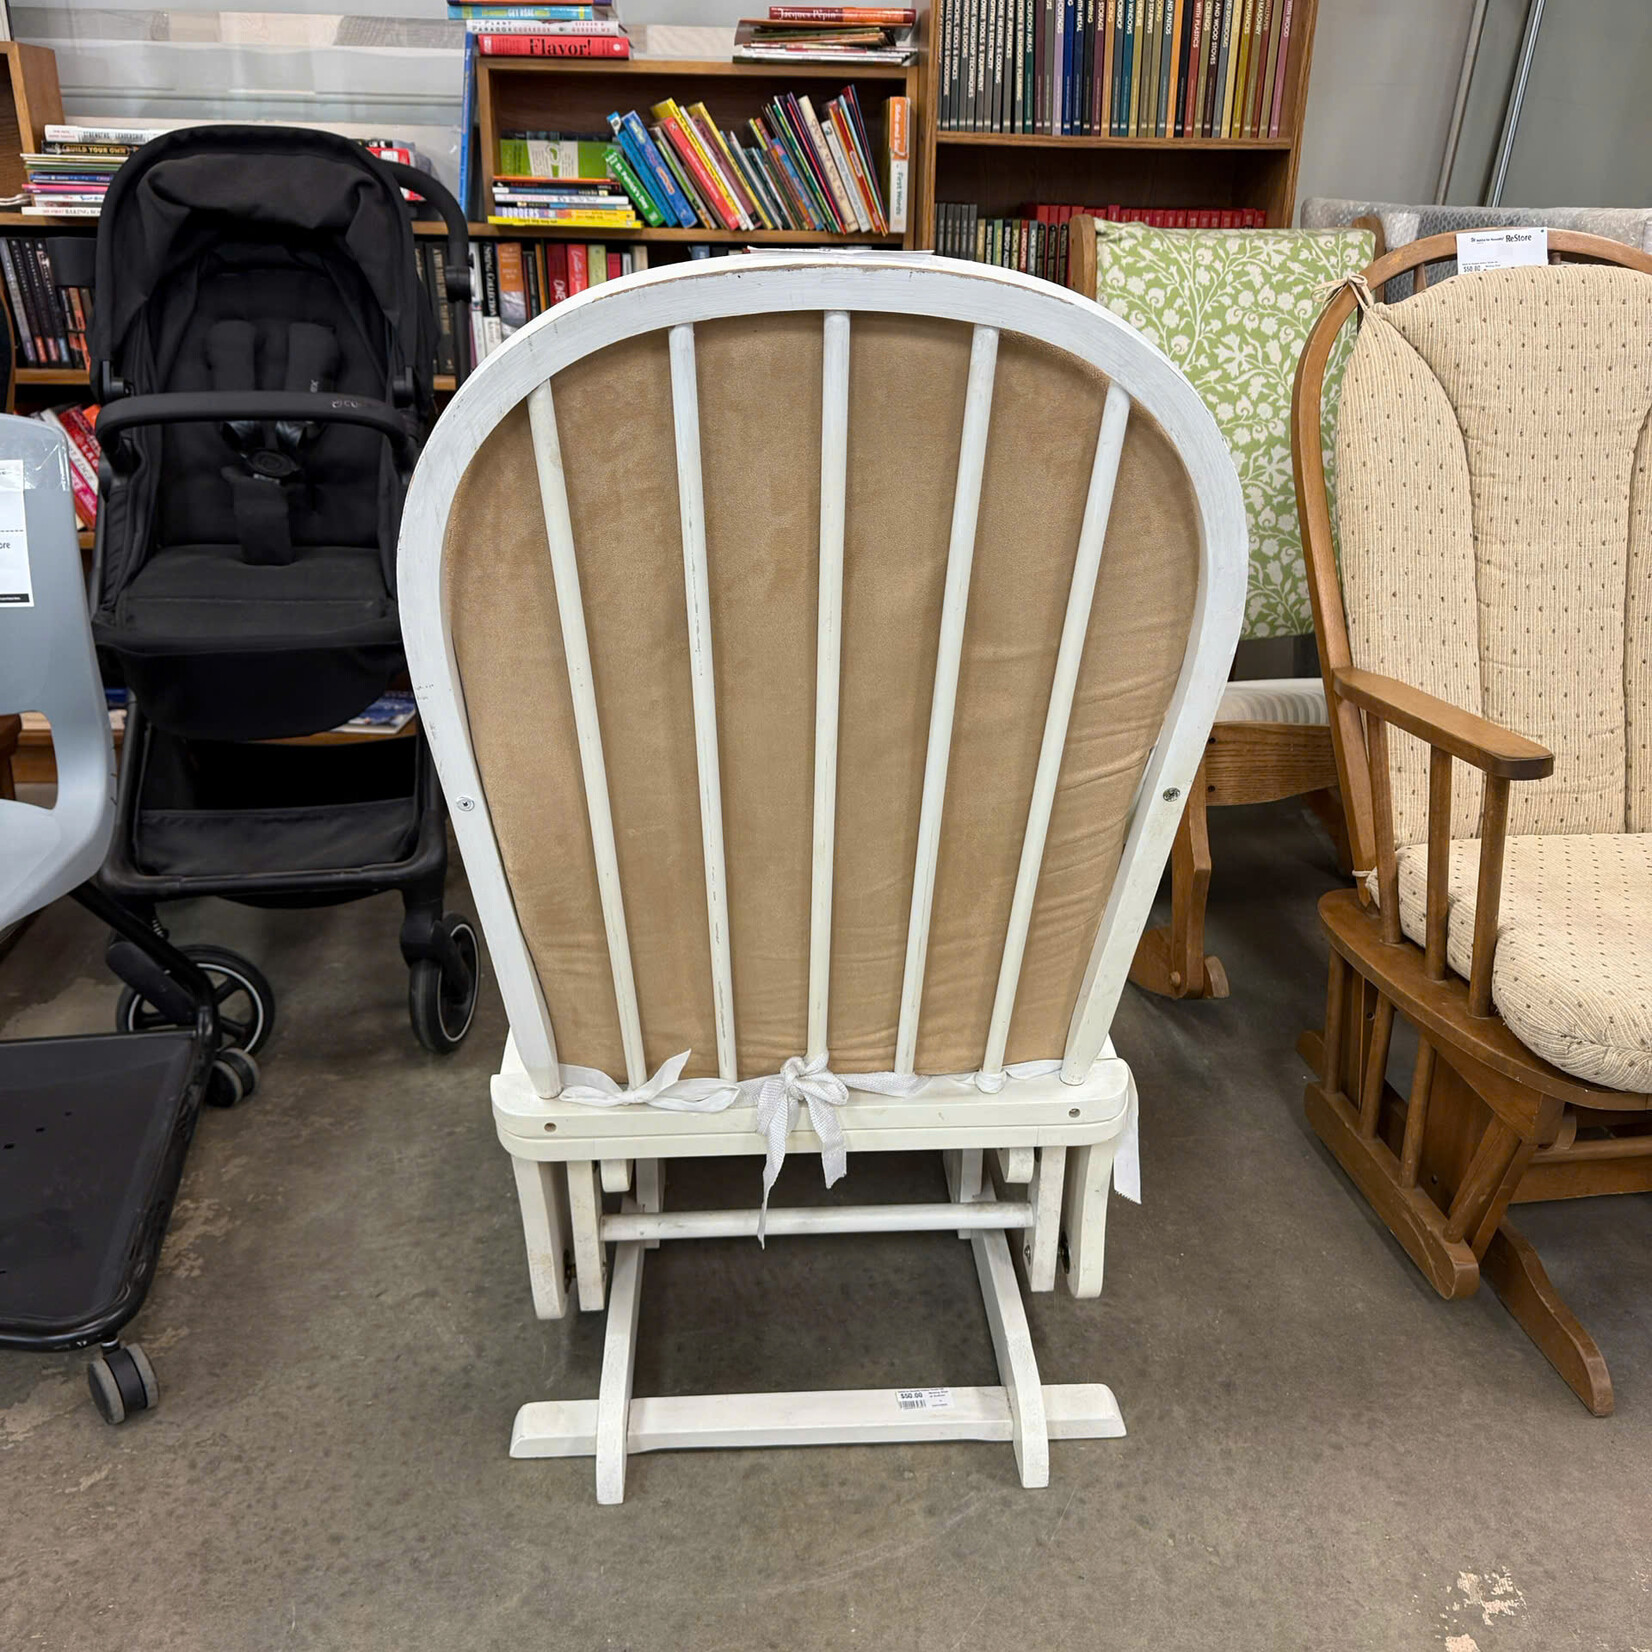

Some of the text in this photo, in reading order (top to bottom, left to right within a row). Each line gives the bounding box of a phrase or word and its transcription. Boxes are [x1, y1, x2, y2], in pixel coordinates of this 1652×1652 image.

[777, 8, 811, 20] Jacques
[1126, 3, 1134, 35] WINDOWS
[1283, 16, 1291, 38] WOOD
[1192, 19, 1200, 48] PLASTICS
[1223, 10, 1231, 48] BATHROOMS
[530, 38, 592, 56] Flavor!
[621, 170, 641, 198] Patrick's
[638, 194, 649, 209] Day
[895, 172, 904, 216] First Words
[1505, 234, 1532, 243] ReStore
[484, 246, 492, 272] SPRING
[486, 273, 498, 316] COLLECTION
[553, 279, 566, 300] ONE
